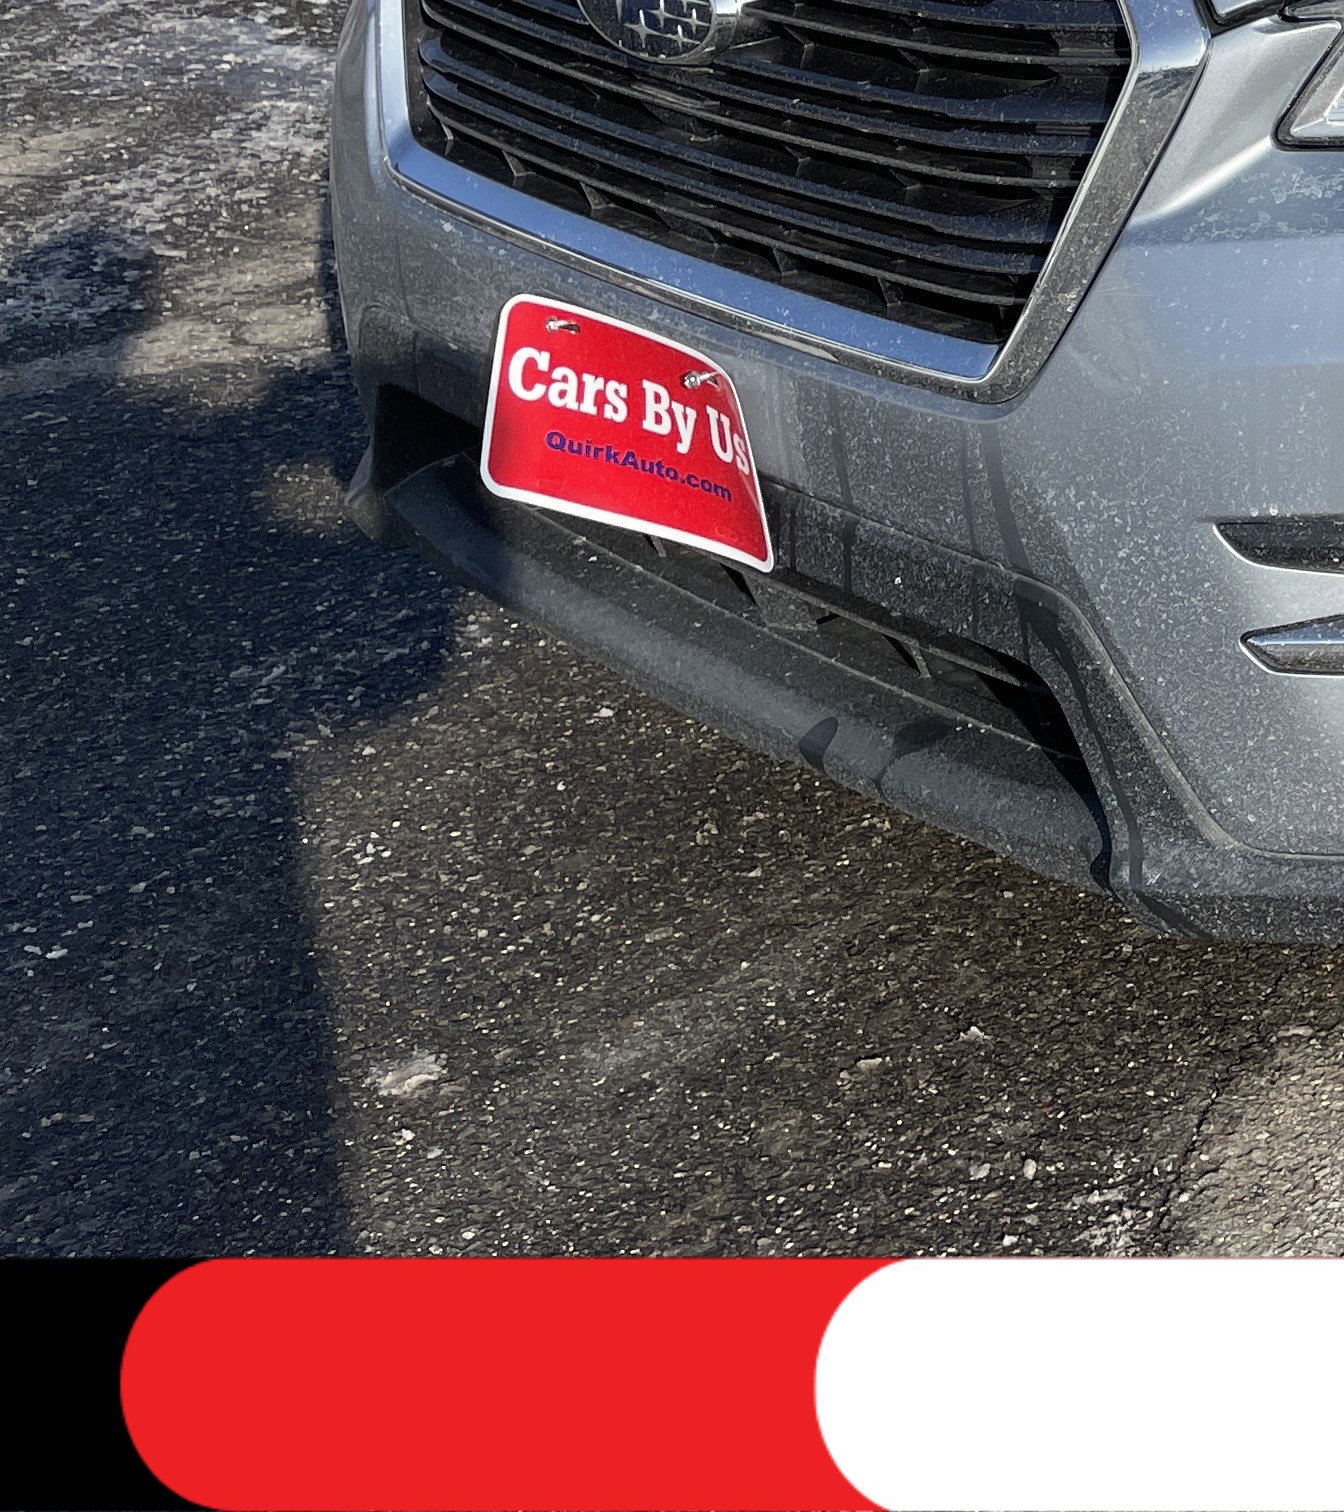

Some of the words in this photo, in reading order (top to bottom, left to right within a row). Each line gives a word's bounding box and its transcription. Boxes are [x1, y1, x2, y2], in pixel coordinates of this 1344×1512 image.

[508, 347, 628, 424] Cars
[641, 378, 698, 454] By
[706, 405, 750, 476] Us
[545, 430, 732, 503] QuirkAuto.com
